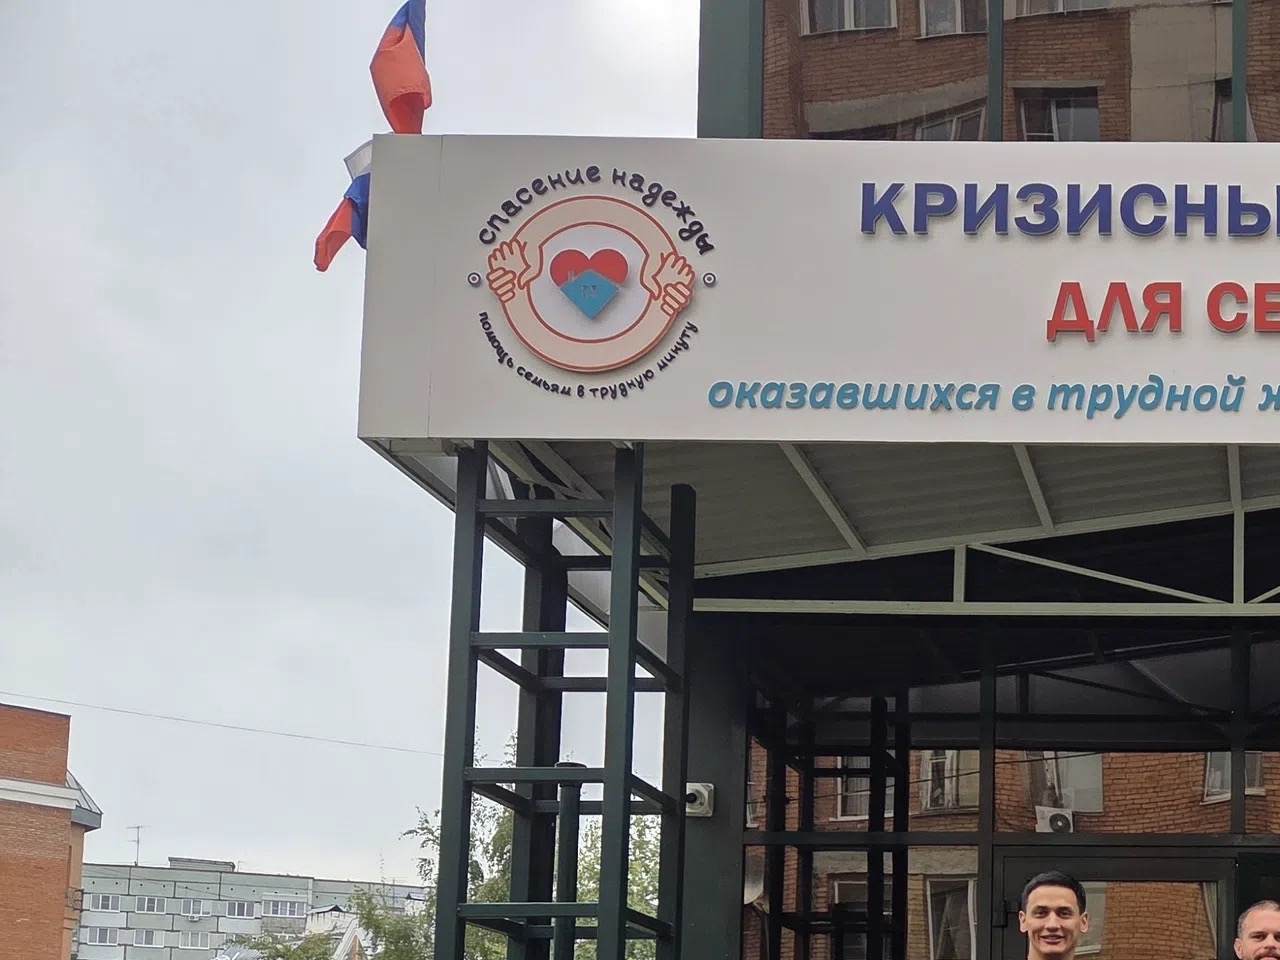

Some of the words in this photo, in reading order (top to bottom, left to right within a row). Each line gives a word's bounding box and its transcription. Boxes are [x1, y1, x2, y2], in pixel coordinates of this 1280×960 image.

[479, 165, 601, 245] спасение
[612, 168, 715, 255] надежды
[1046, 281, 1183, 342] ДЛЯ
[479, 311, 514, 368] помощь
[516, 366, 571, 397] семьям
[577, 384, 585, 398] в
[589, 369, 655, 399] трудную
[657, 321, 699, 371] минуту
[707, 380, 1001, 411] оказавшихся
[1011, 384, 1036, 411] в
[1047, 374, 1247, 419] трудной
